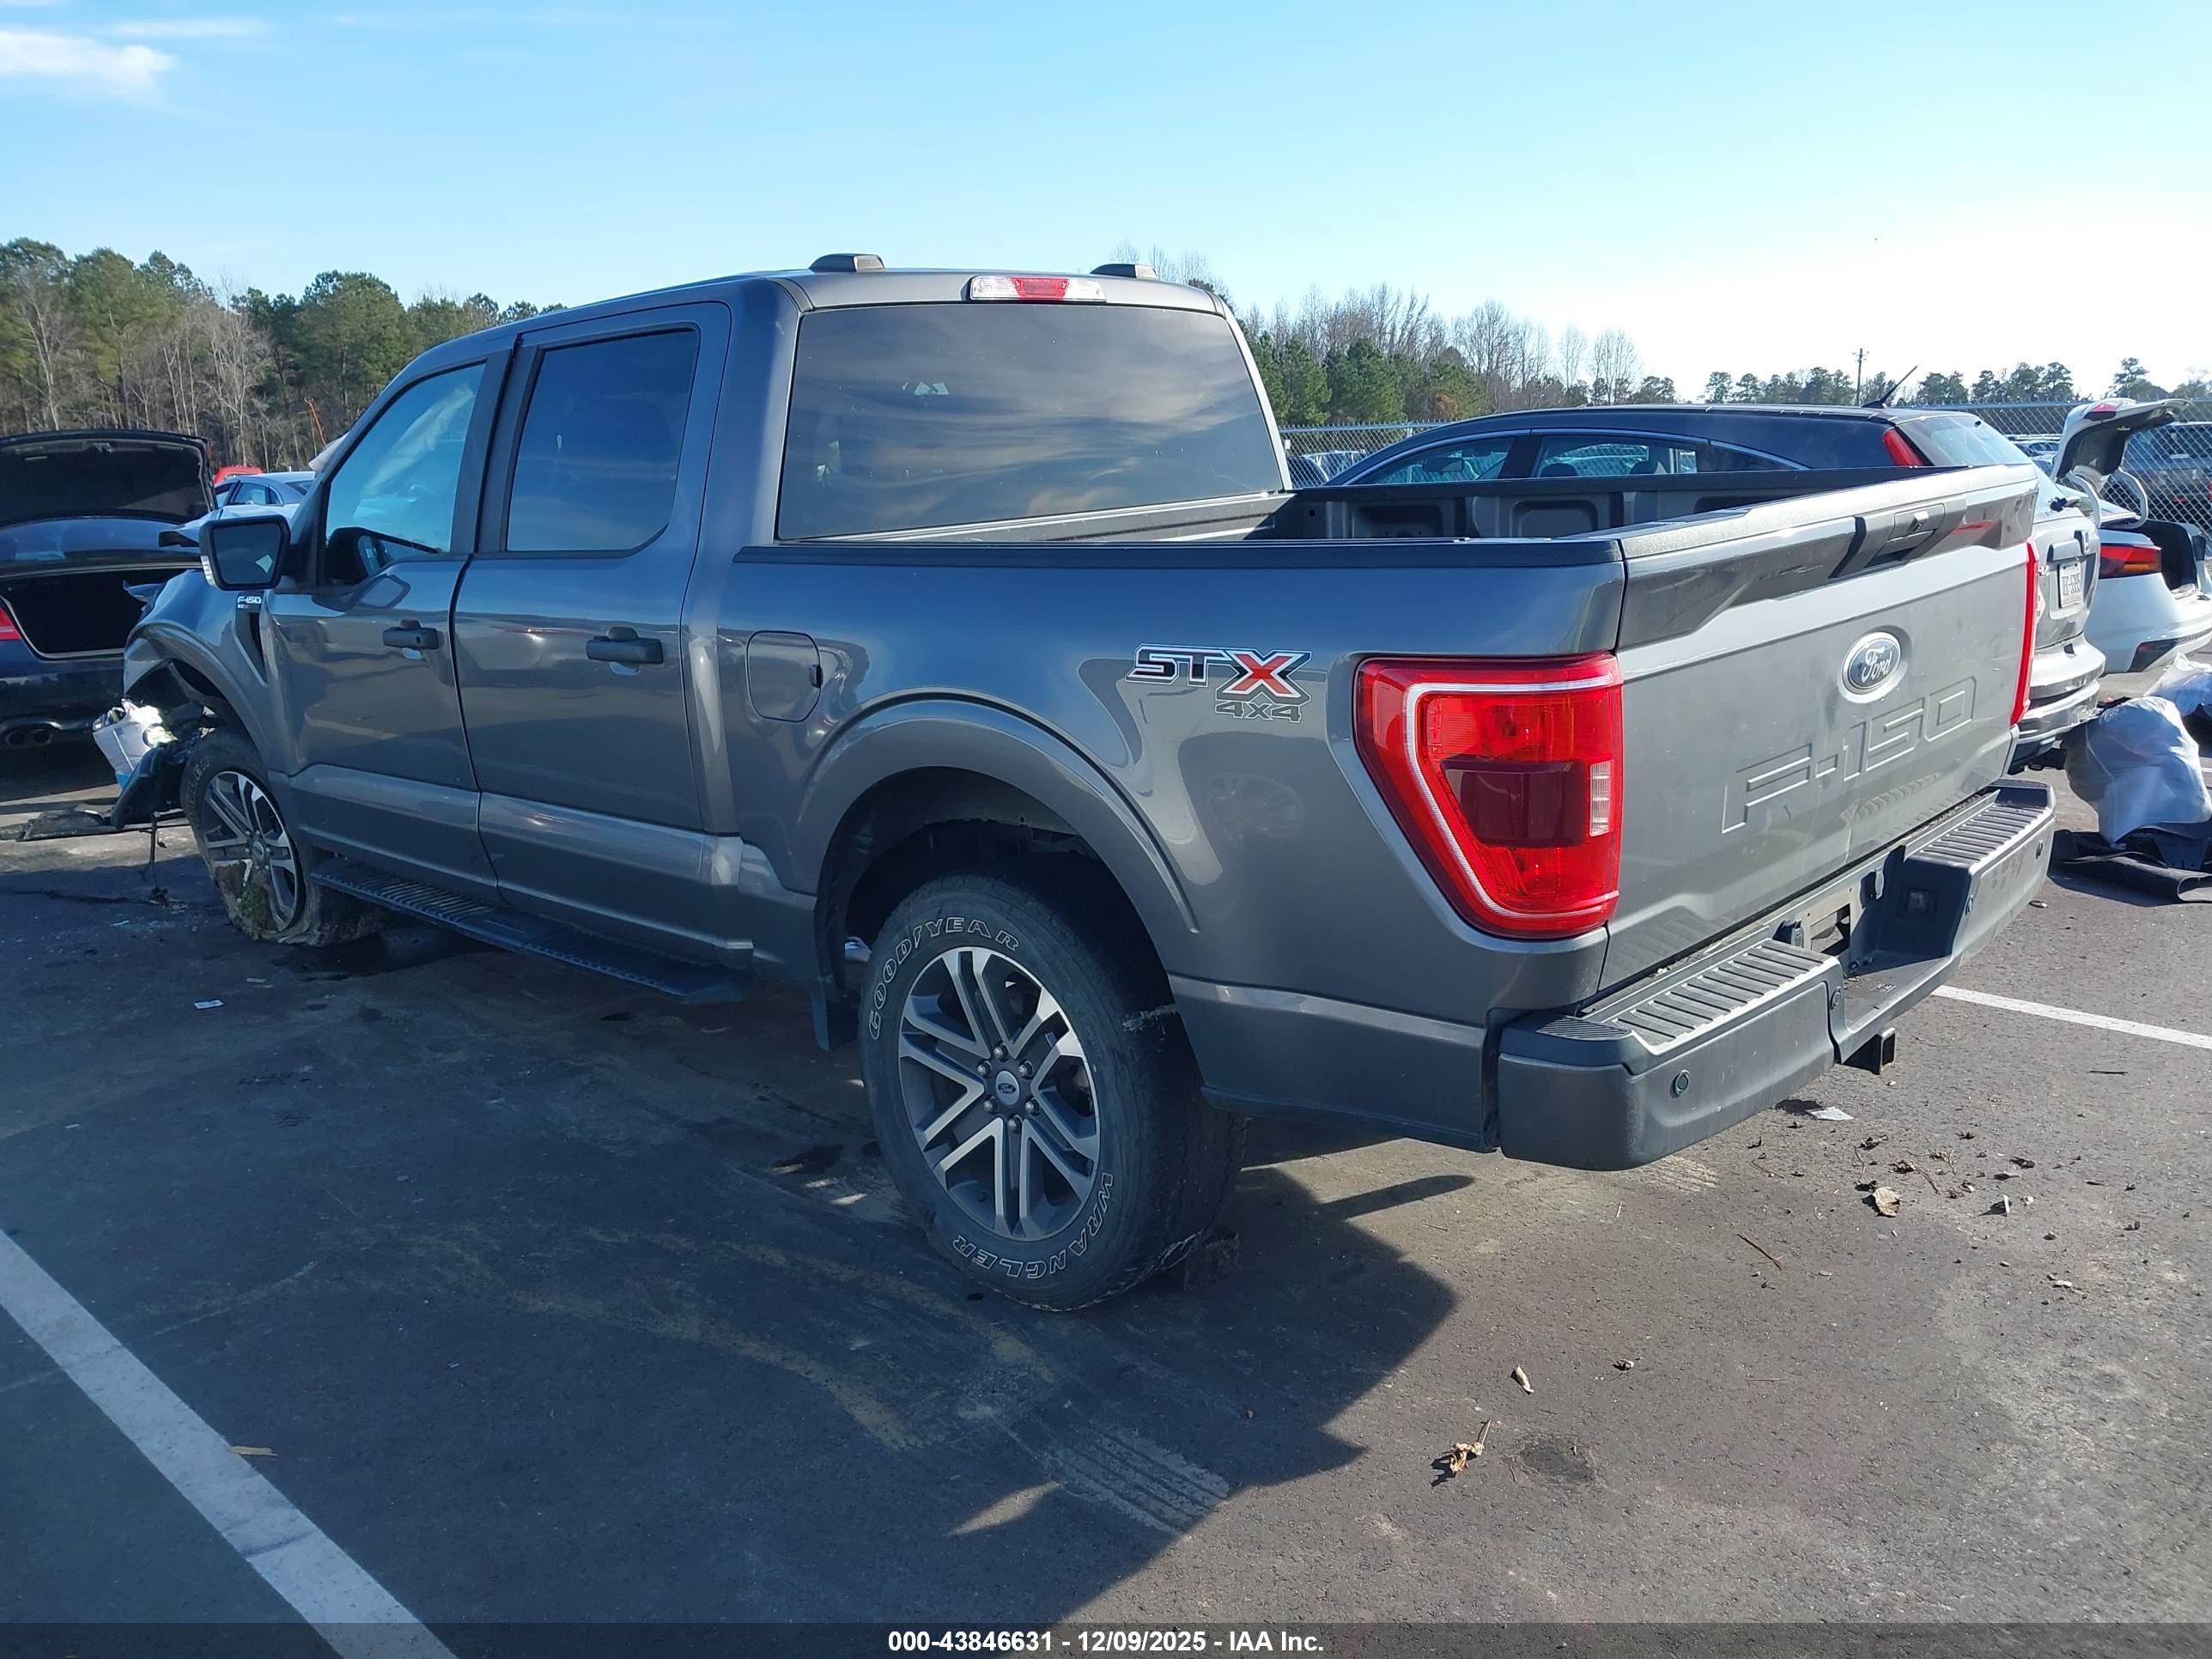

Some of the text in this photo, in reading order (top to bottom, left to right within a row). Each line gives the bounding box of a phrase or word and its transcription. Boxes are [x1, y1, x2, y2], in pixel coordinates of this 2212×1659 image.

[1125, 643, 1312, 706] STX
[1722, 676, 1977, 835] F-150
[869, 916, 1019, 1041] GOODYEAR
[952, 1171, 1115, 1279] WRANGLER
